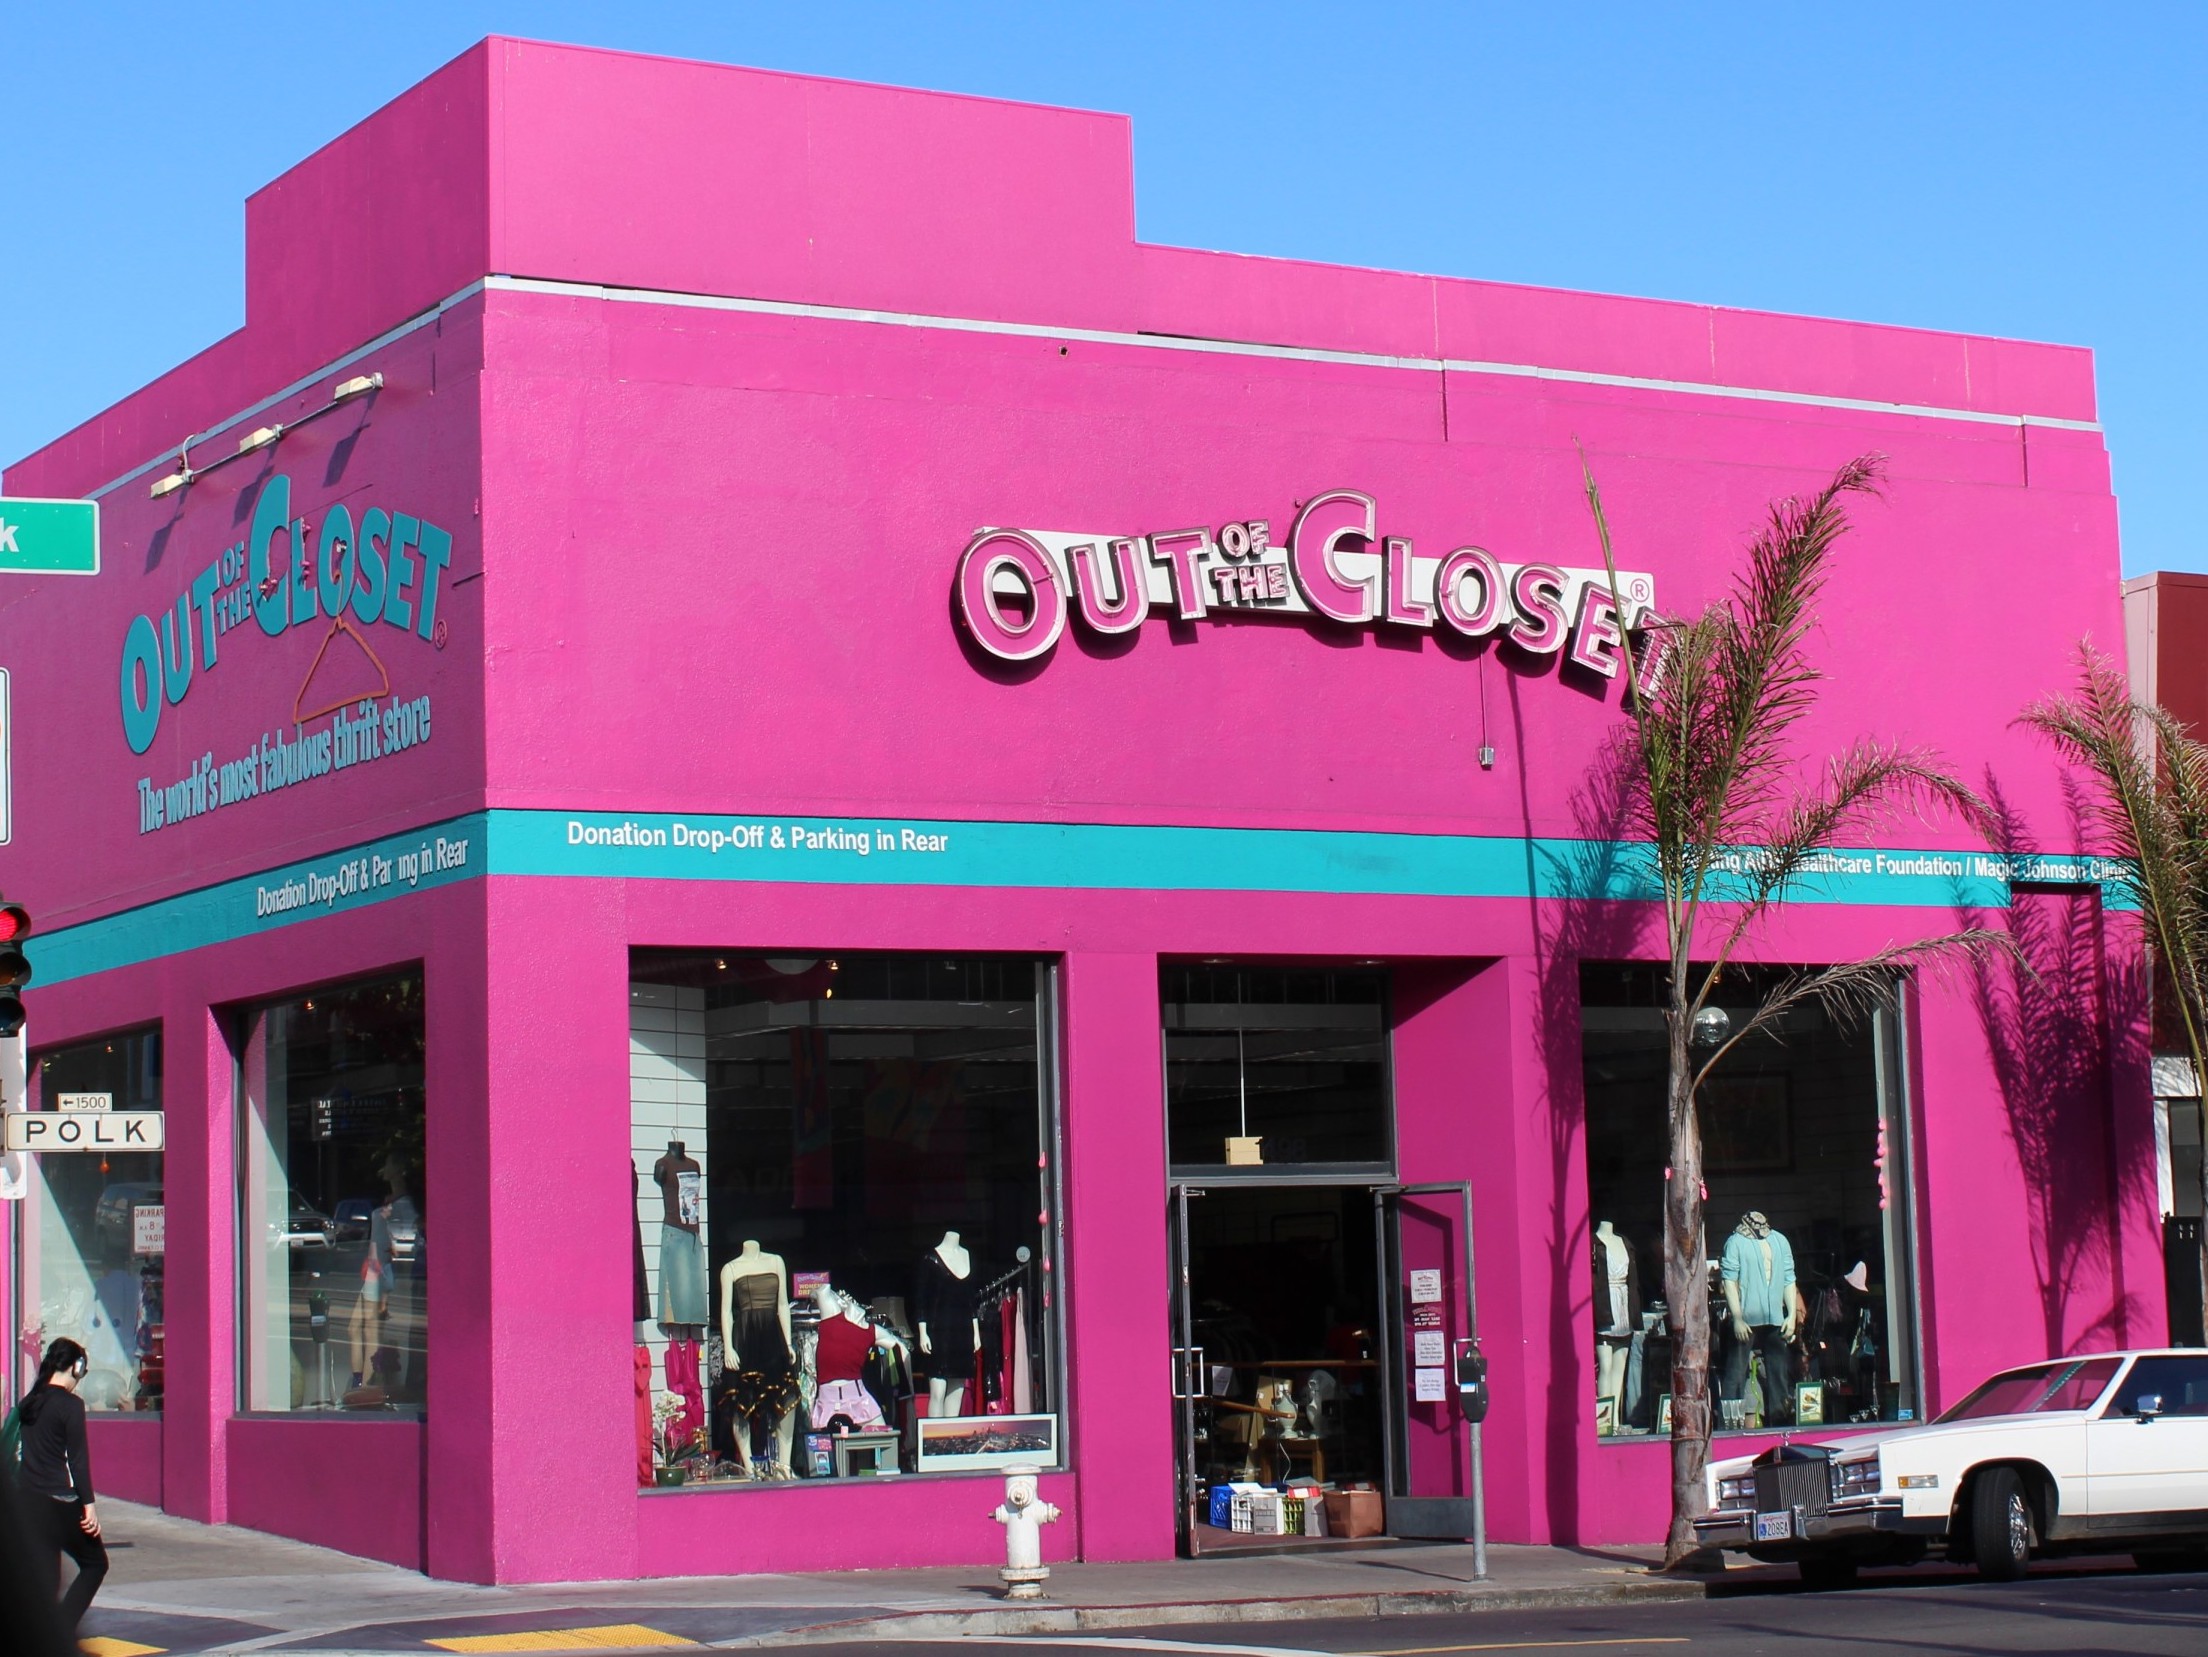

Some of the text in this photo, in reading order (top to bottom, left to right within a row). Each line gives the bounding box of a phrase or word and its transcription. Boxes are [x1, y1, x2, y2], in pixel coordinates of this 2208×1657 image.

[222, 541, 245, 587] OF
[249, 473, 453, 642] CLOSET
[1221, 519, 1270, 558] OF
[217, 580, 251, 636] THE
[950, 527, 1212, 662] OUT
[1211, 562, 1291, 605] THE
[1284, 487, 1676, 701] CLOSET
[120, 558, 220, 755] OUT
[138, 695, 431, 834] The world's most fabulous thrift store
[567, 821, 949, 855] Donation Drop-Off & Parking in Rear
[257, 879, 307, 916] Donation
[308, 860, 359, 906] Drop-Off
[360, 859, 369, 890] &
[421, 842, 433, 876] in
[436, 837, 469, 871] Rear
[1876, 854, 1962, 877] Foundation
[1965, 859, 1971, 876] /
[1974, 858, 2018, 882] Magic
[2023, 859, 2087, 880] Johnson
[76, 1096, 107, 1109] 1500
[25, 1120, 147, 1144] POLK
